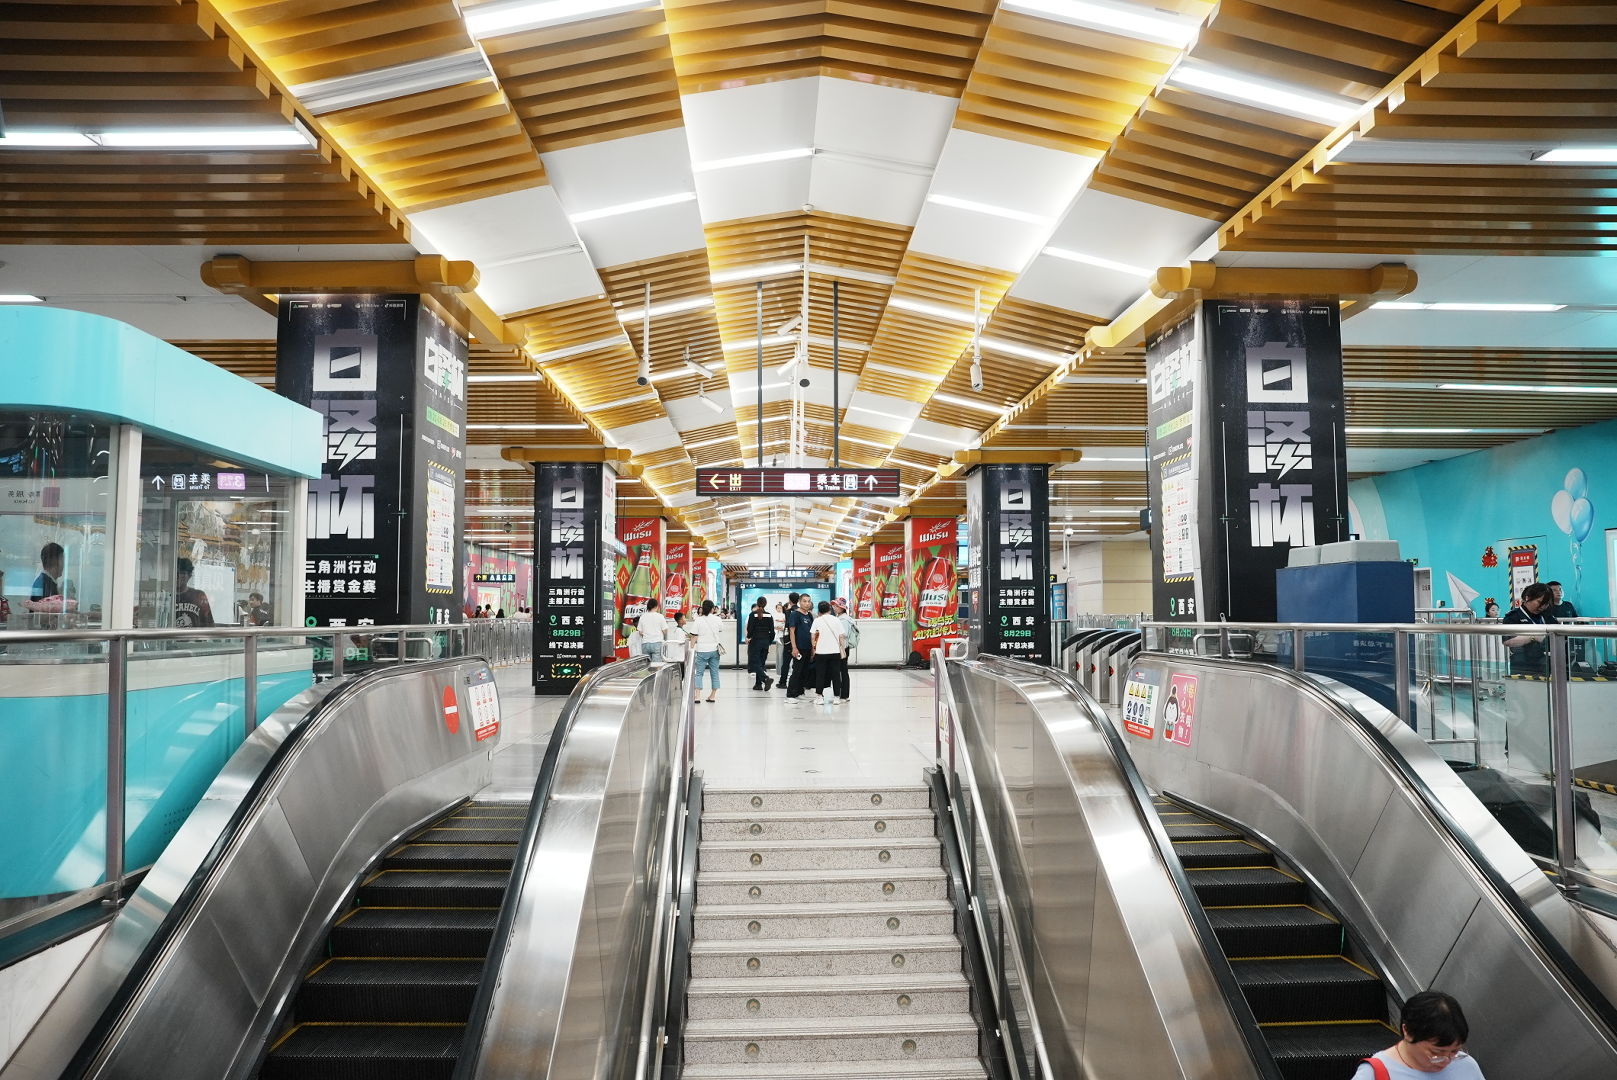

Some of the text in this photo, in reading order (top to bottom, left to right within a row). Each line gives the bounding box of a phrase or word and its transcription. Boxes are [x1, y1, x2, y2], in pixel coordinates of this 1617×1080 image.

[816, 474, 840, 485] 乘车
[919, 531, 949, 543] Wusu
[305, 560, 377, 574] 三角洲行动
[304, 579, 377, 593] 主播赏金赛
[548, 588, 585, 596] 三角洲行动
[999, 589, 1035, 597] 三角洲行动
[1177, 597, 1195, 615] 西安
[561, 616, 585, 625] 西安
[1012, 616, 1035, 626] 西安
[552, 629, 581, 637] 8月29日
[1003, 629, 1032, 637] 8月29日
[548, 641, 585, 649] 线下总决赛
[1000, 642, 1035, 650] 线下总决赛
